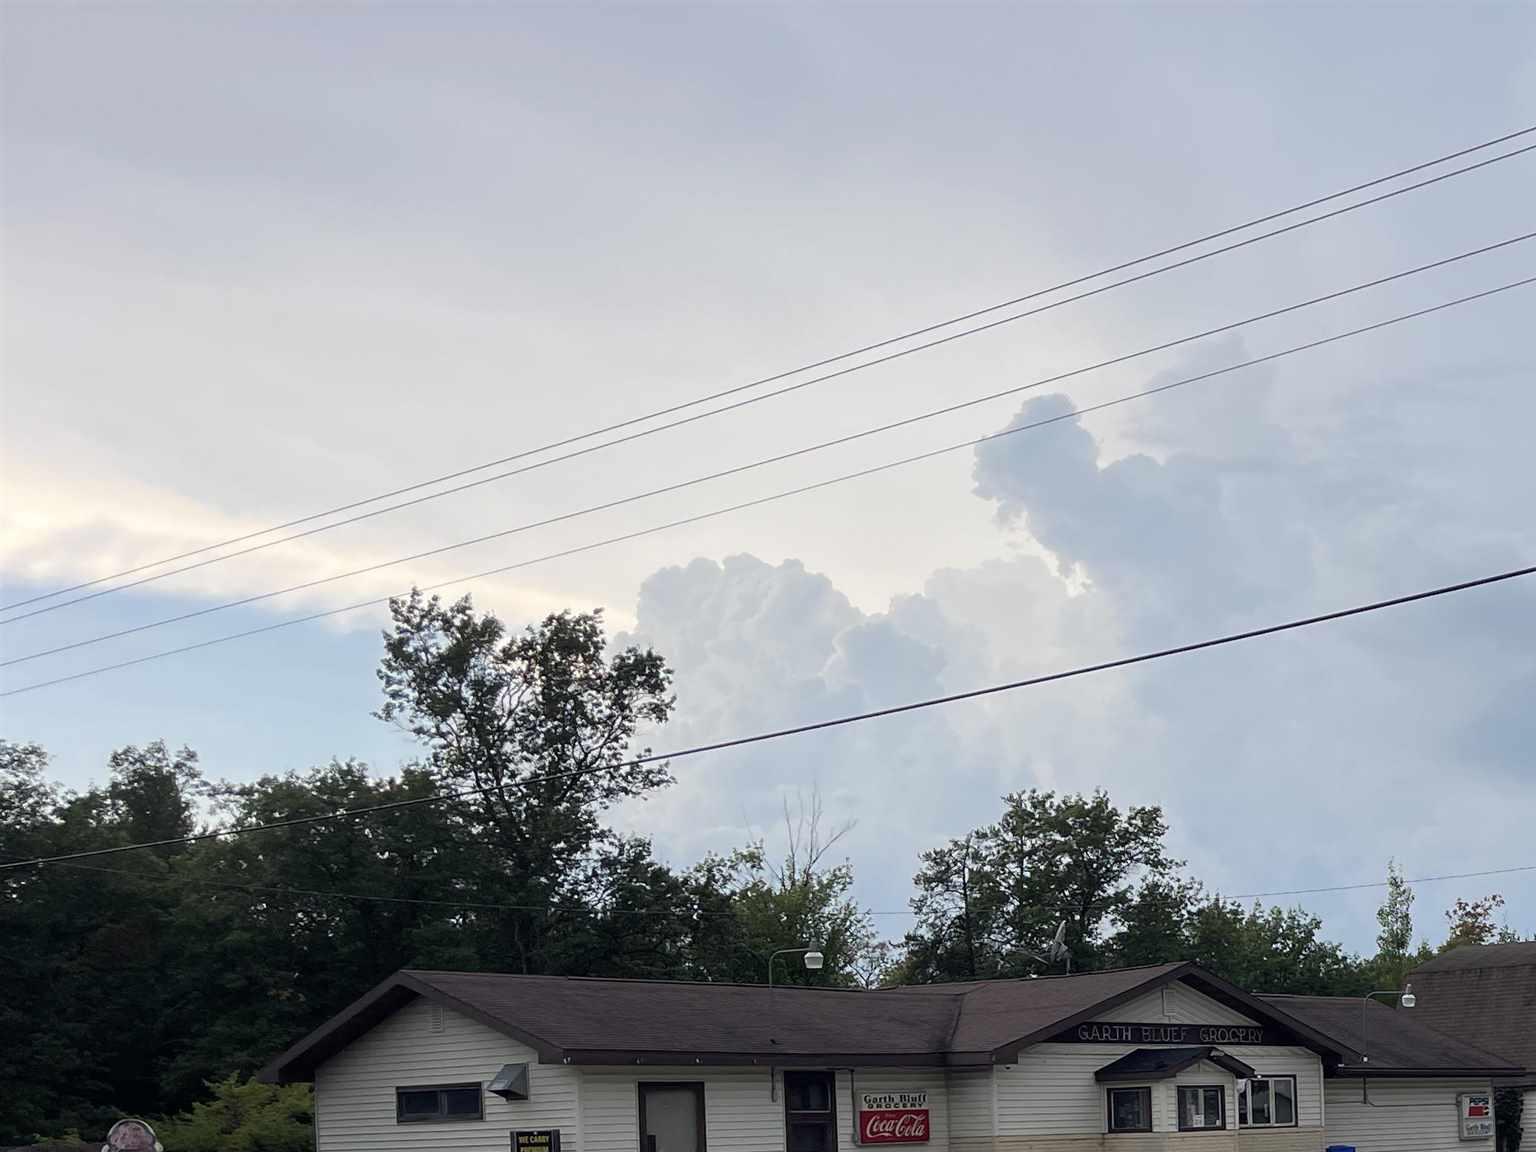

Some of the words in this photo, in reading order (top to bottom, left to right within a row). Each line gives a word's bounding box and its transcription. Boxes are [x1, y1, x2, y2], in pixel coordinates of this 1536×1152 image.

[1077, 1025, 1132, 1041] GARTH
[1141, 1026, 1188, 1042] BLUFF
[1199, 1028, 1265, 1043] GROCERY
[863, 1094, 895, 1104] Garth
[899, 1094, 927, 1103] Bluff
[866, 1113, 927, 1138] Coca-Cola
